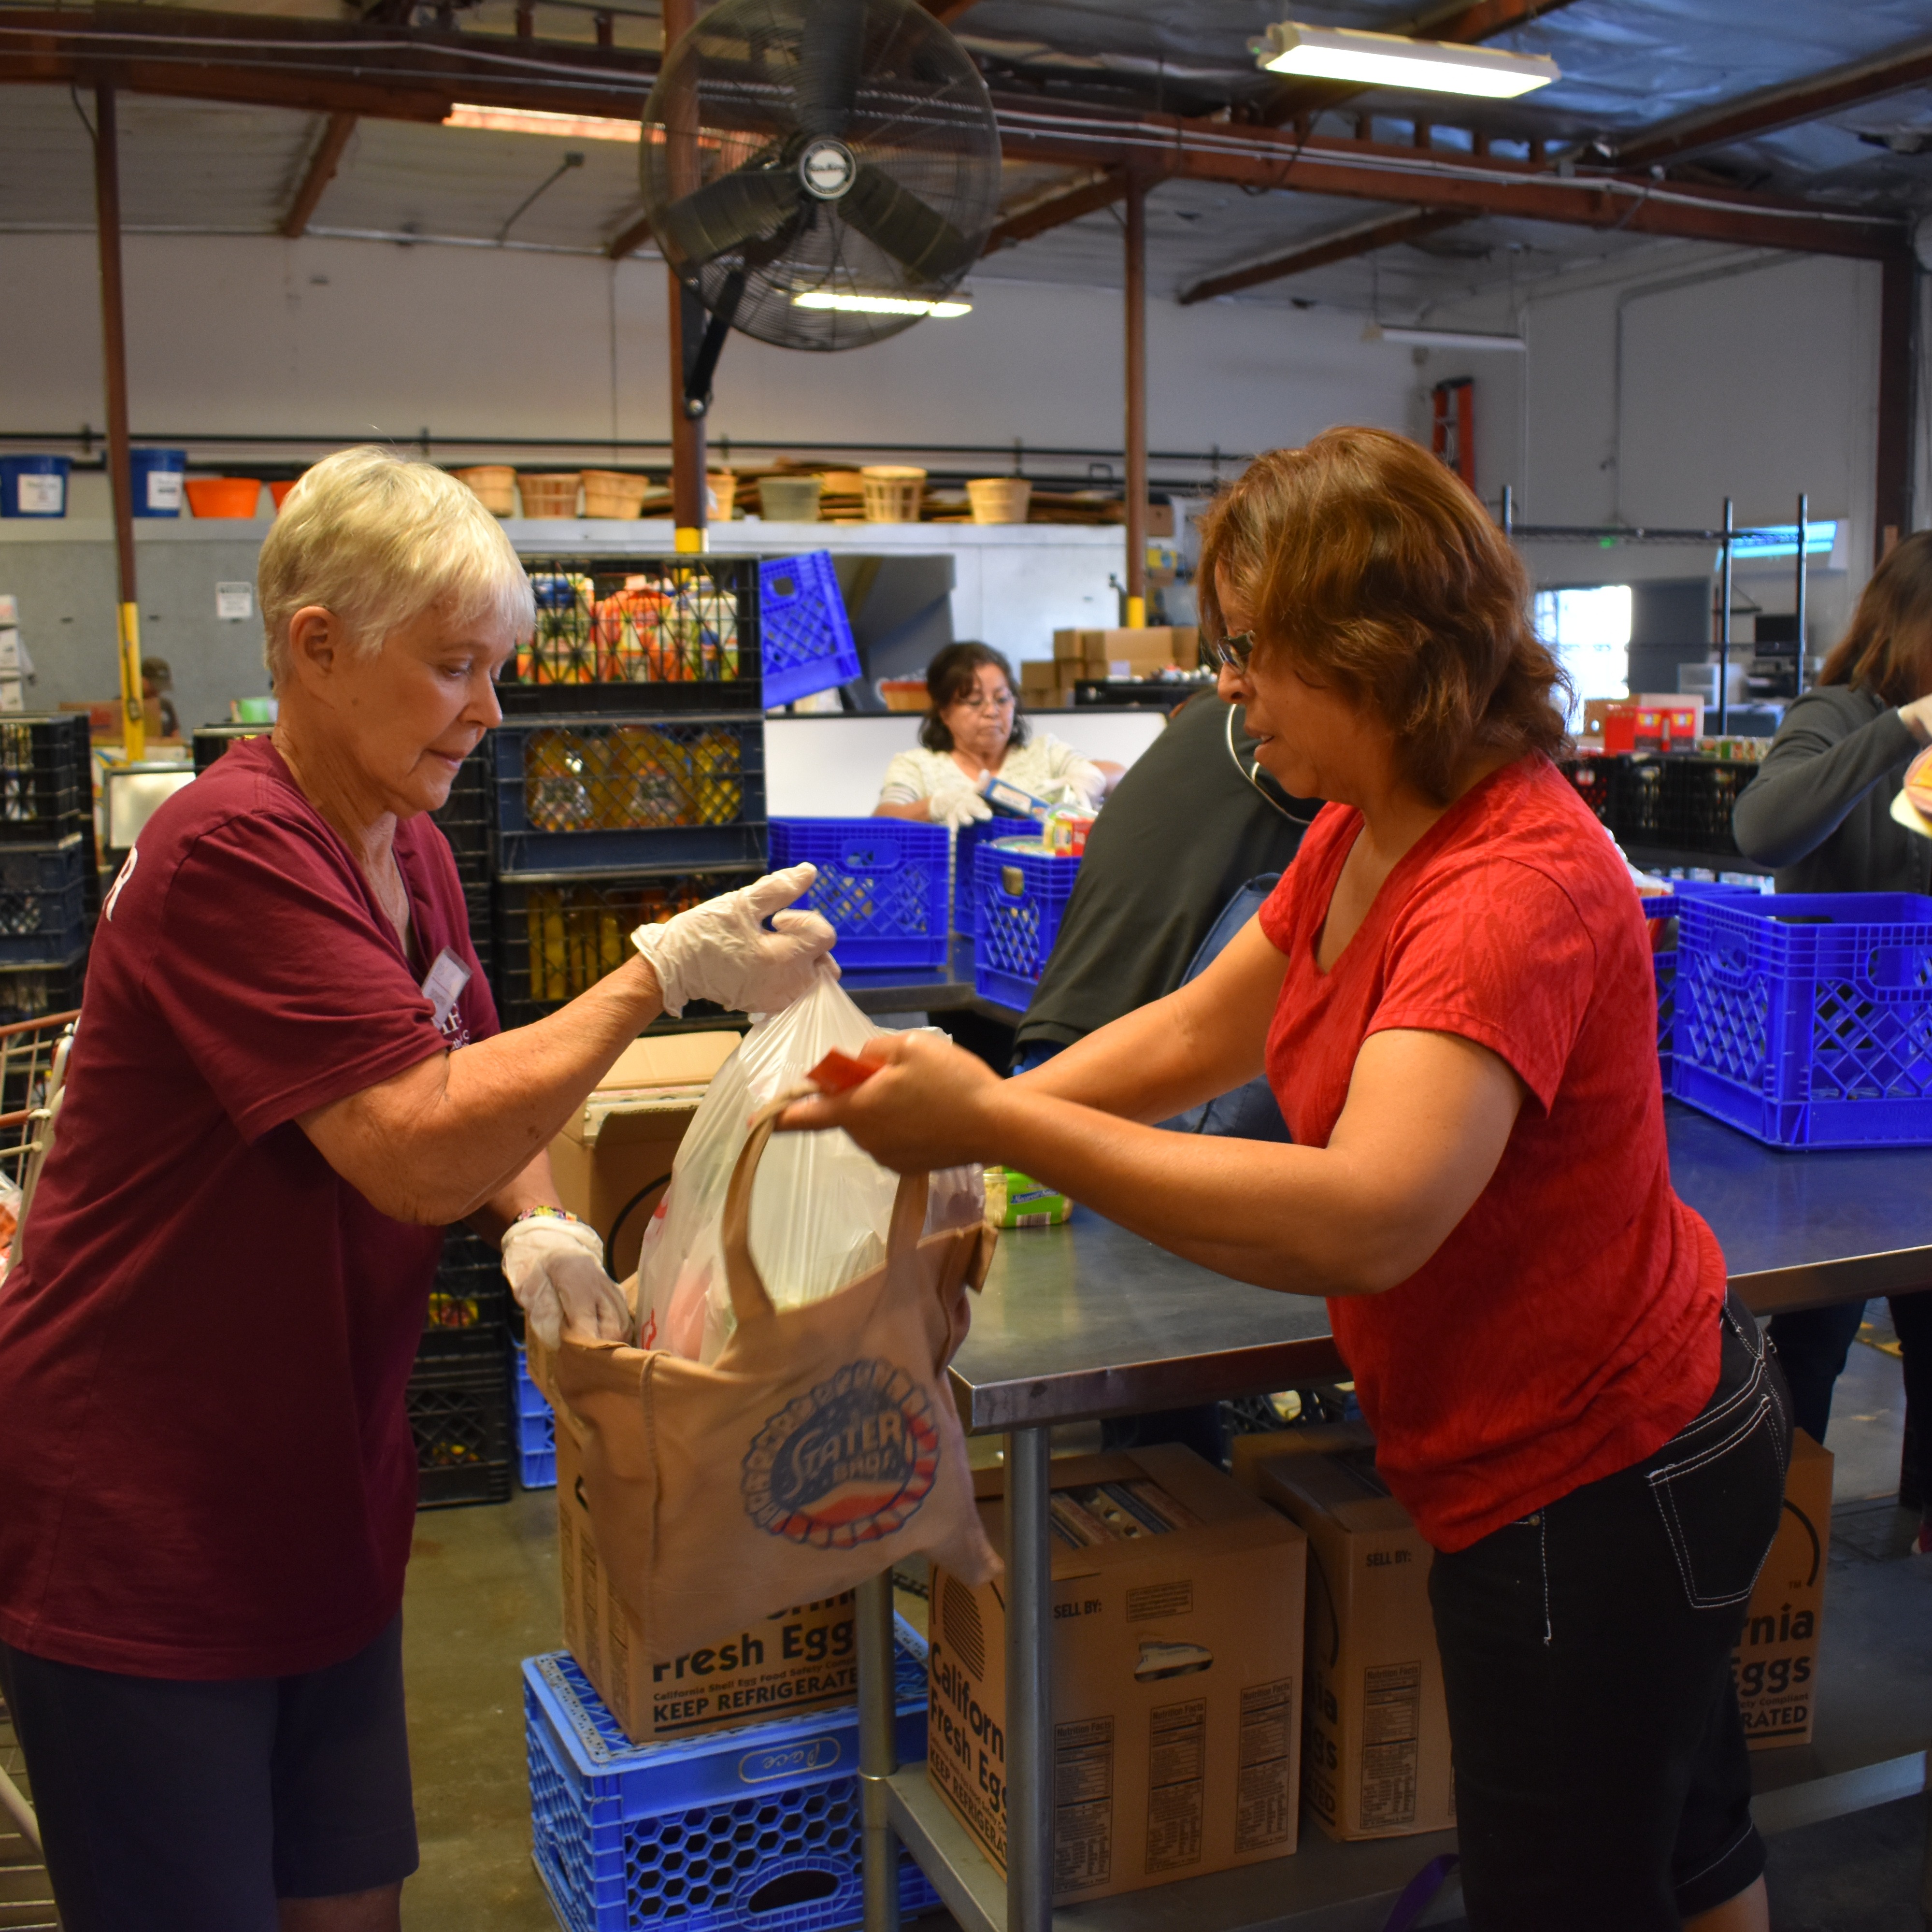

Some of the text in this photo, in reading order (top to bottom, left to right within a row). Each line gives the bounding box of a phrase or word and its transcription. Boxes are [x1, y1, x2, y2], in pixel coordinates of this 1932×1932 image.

[1367, 1549, 1412, 1567] SELL BY:
[1789, 1580, 1802, 1589] TM
[1054, 1598, 1102, 1619] SELL BY:
[783, 1619, 855, 1662] Egg
[654, 1687, 705, 1701] California
[709, 1681, 734, 1692] Shell
[738, 1678, 757, 1689] Egg
[760, 1671, 787, 1682] Food
[790, 1664, 822, 1677] Safety
[654, 1667, 858, 1723] KEEP REFRIGERATE
[931, 1642, 1005, 1763] Californ
[1759, 1692, 1809, 1706] Compliant
[930, 1686, 971, 1772] Fresh
[930, 1745, 1007, 1858] KEEP REFRIGERAT
